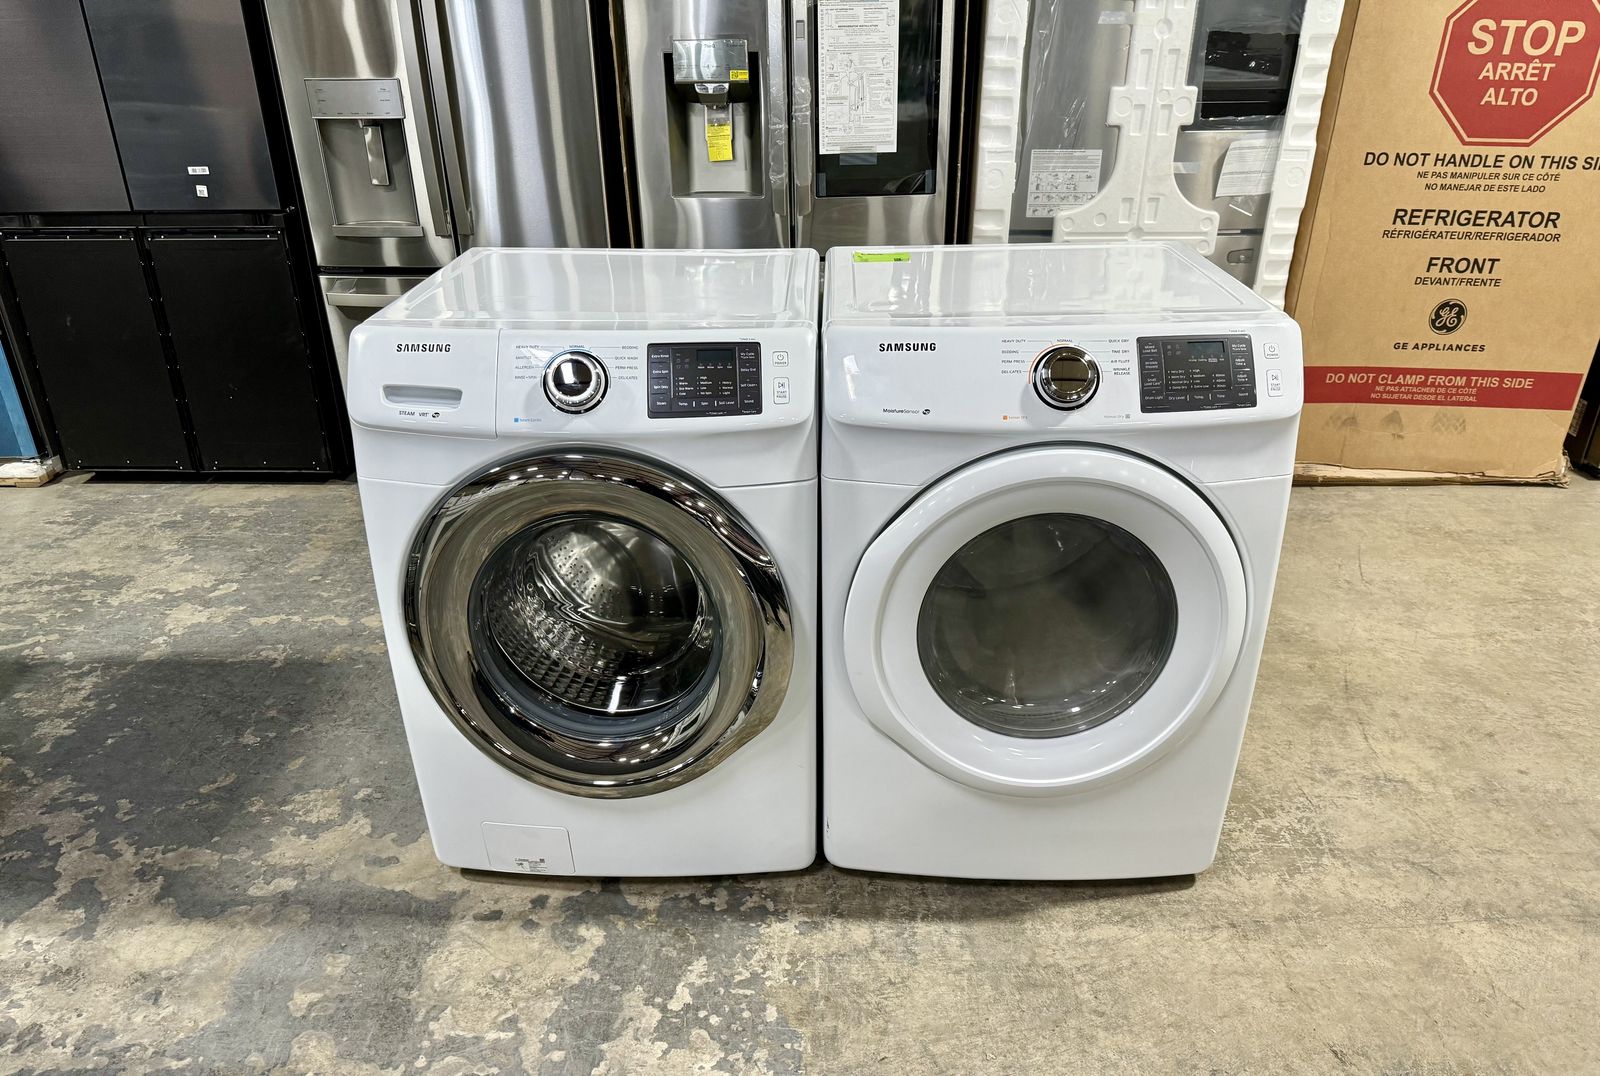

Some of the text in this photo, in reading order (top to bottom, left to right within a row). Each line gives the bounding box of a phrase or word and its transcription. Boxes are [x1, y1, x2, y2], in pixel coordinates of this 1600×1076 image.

[1467, 18, 1586, 56] STOP
[1478, 58, 1556, 81] ARRÊT
[1480, 87, 1538, 106] ALTO
[1363, 151, 1600, 170] DO NOT HANDLE ON THIS SI
[1417, 171, 1560, 182] NE PAS MANIPULER SUR CE CÔTÉ
[1425, 183, 1546, 193] NO MANEJAR DE ESTE LADO
[1392, 208, 1561, 229] REFRIGERATOR
[1382, 227, 1561, 242] RÉFRIGÉRATEUR/REFRIGERADOR
[1426, 256, 1501, 274] FRONT
[1414, 276, 1502, 287] DEVANT/FRENTE
[396, 343, 452, 353] SAMSUNG
[878, 342, 937, 352] SAMSUNG
[1393, 342, 1486, 352] GE APPLIANCES
[1325, 373, 1535, 389] DO NOT CLAMP FROM THIS SIDE
